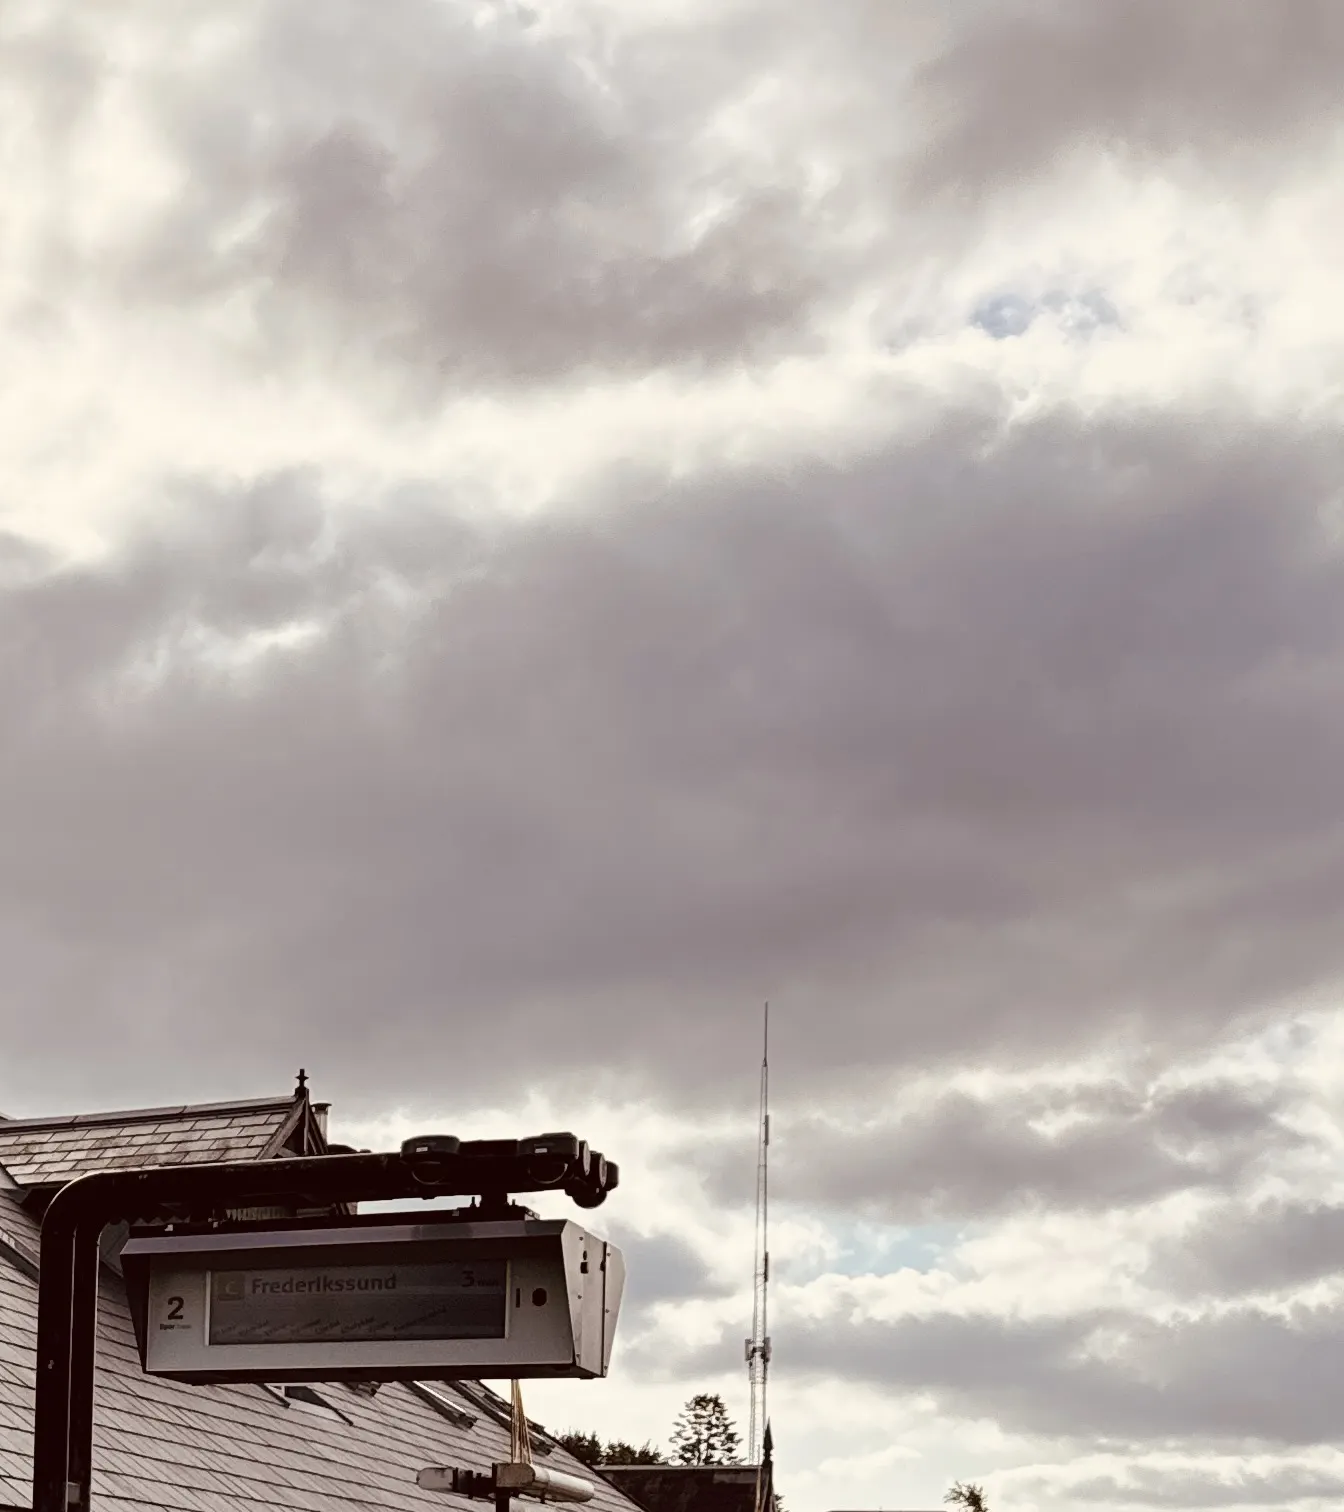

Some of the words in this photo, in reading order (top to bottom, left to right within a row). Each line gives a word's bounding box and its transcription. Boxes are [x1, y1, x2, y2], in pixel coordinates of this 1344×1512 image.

[251, 1273, 397, 1295] Frederikssund
[461, 1270, 475, 1287] 3
[168, 1296, 184, 1320] 2
